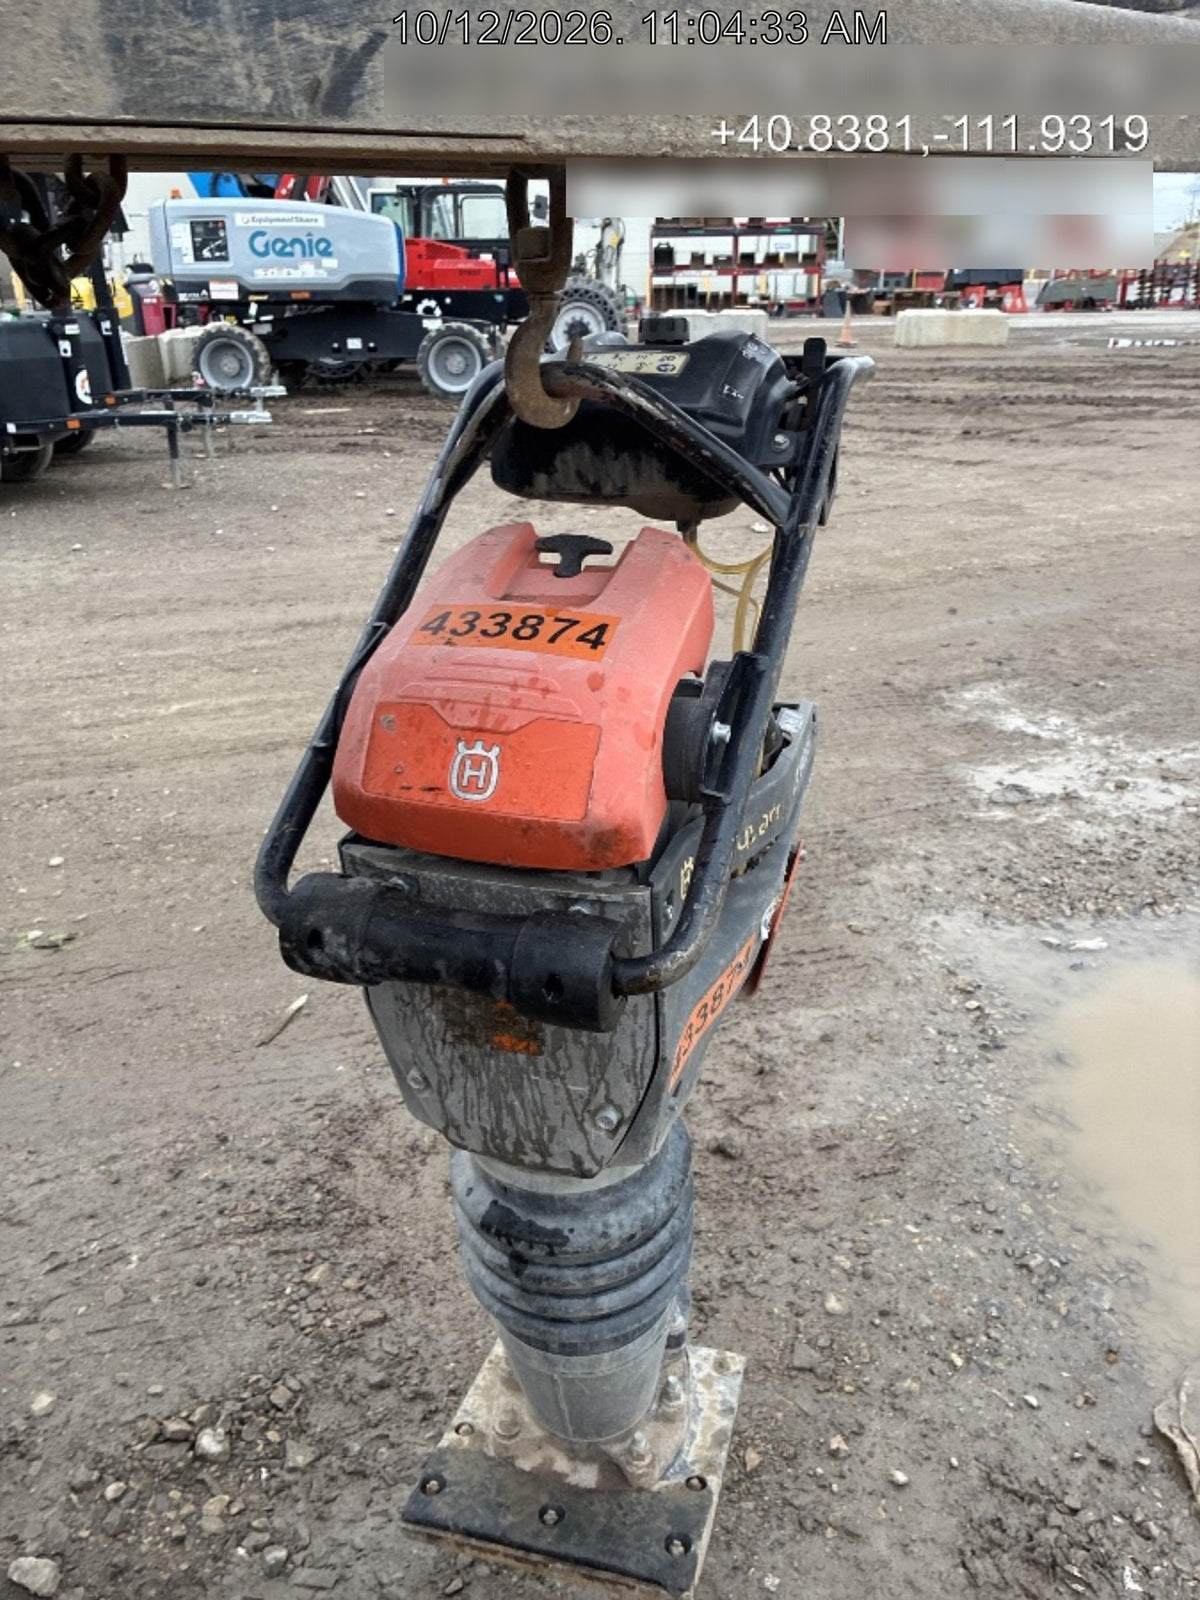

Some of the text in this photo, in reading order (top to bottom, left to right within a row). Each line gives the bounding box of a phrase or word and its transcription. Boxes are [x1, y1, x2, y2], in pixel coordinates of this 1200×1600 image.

[248, 230, 333, 258] Genie
[419, 610, 610, 651] 433874
[673, 948, 752, 1079] 3387
